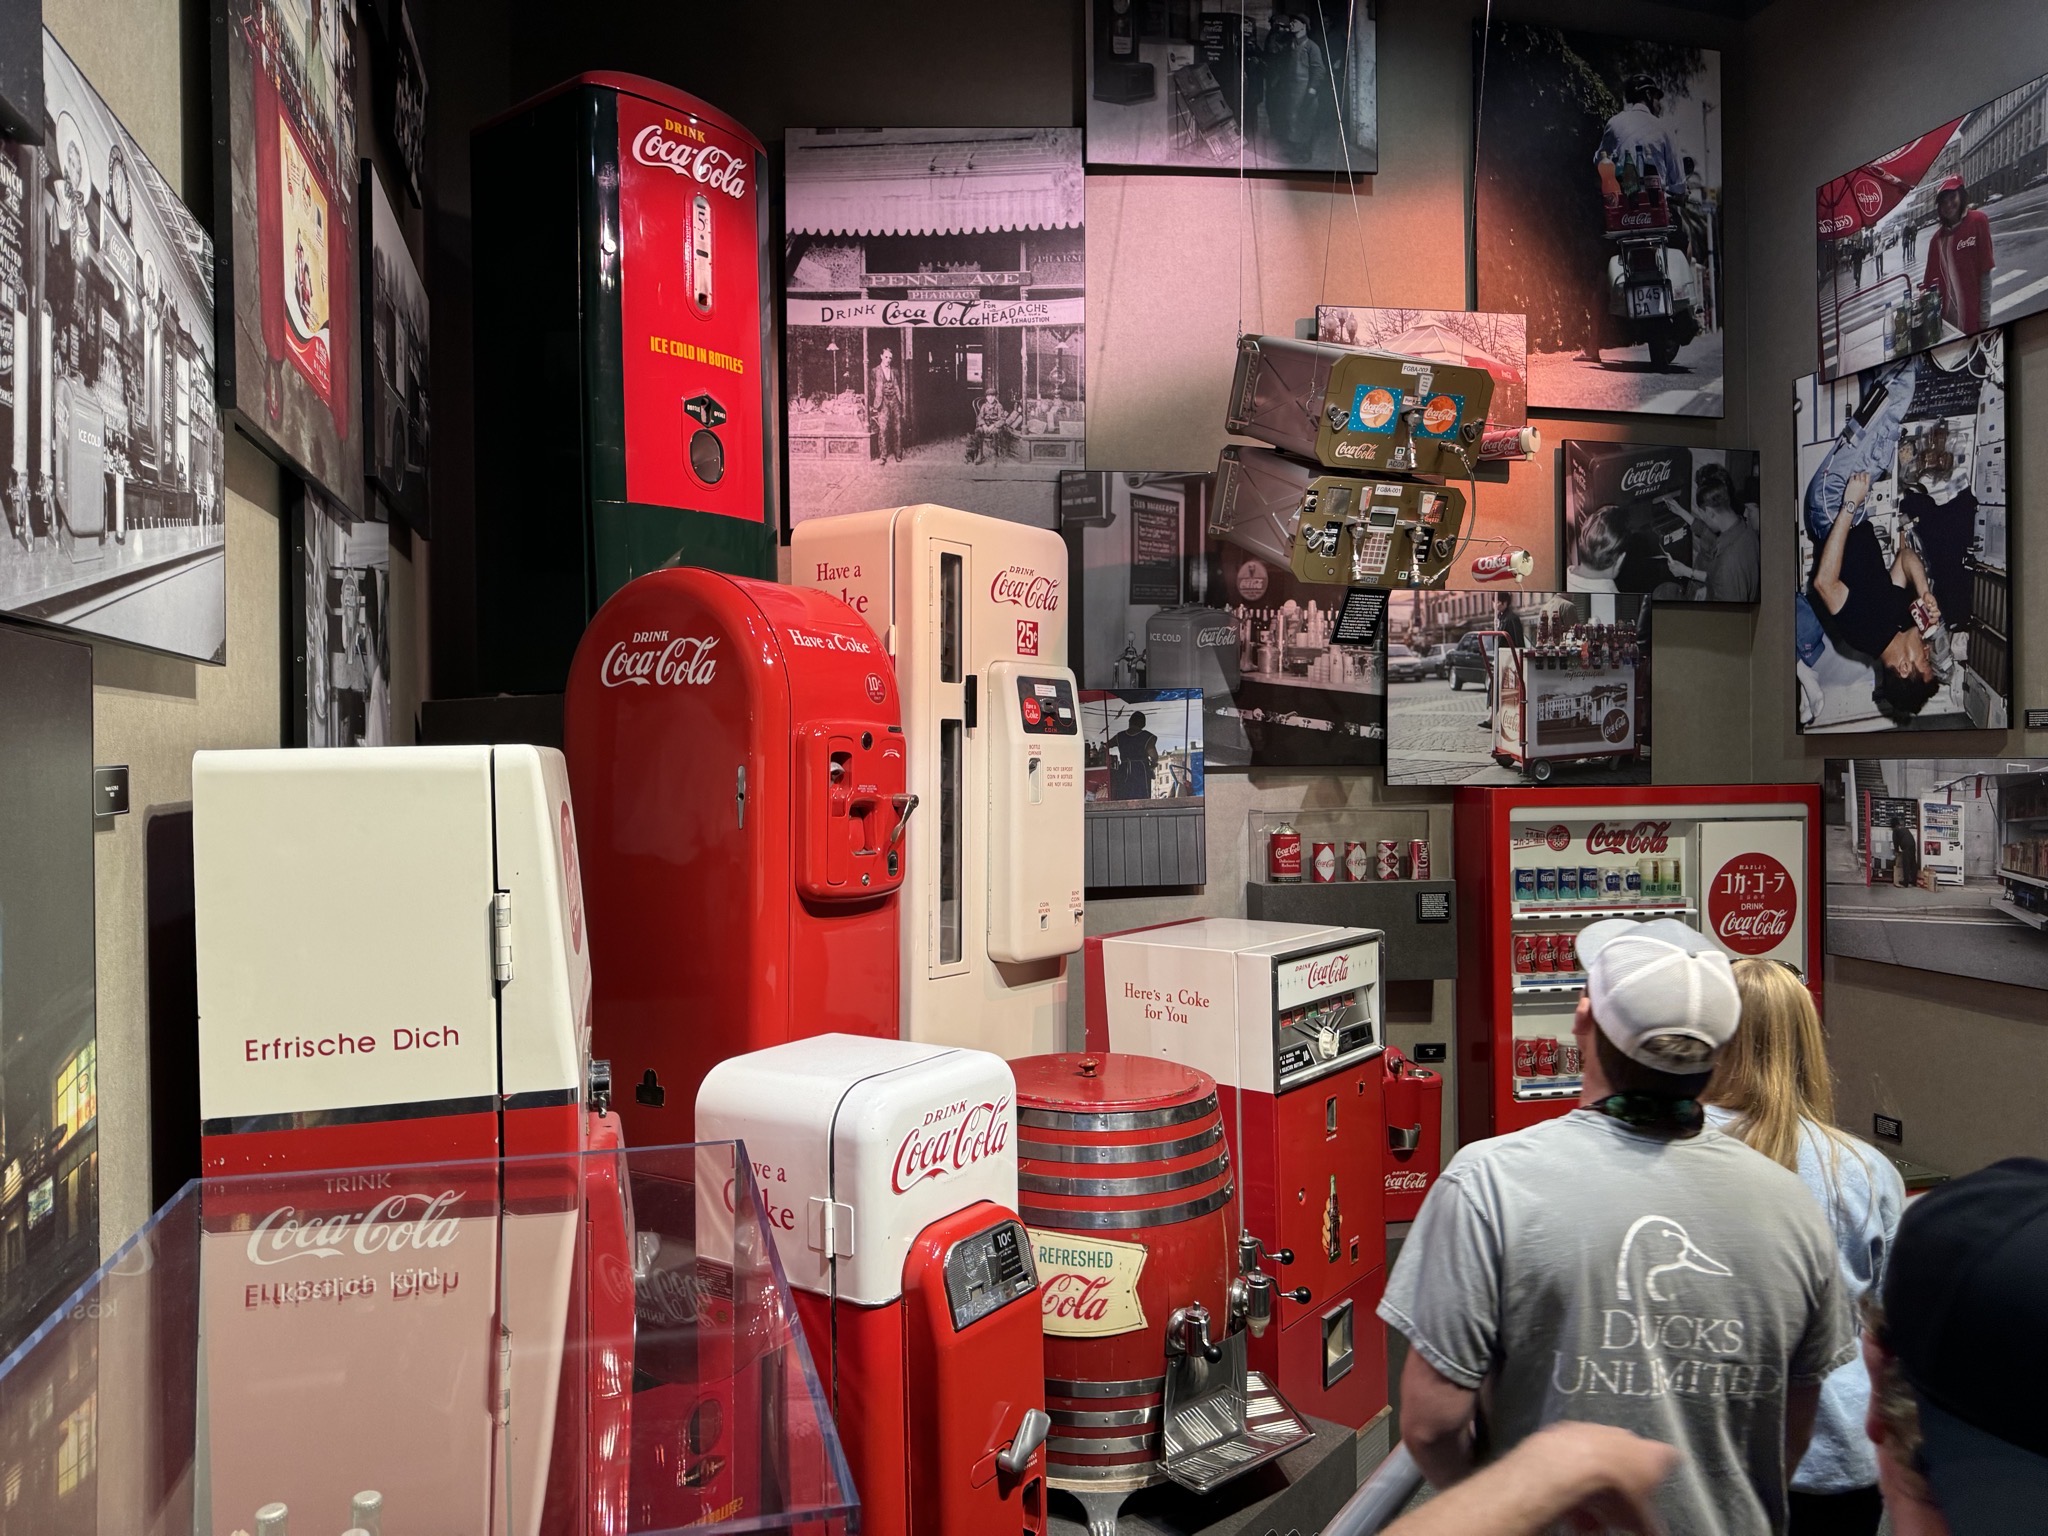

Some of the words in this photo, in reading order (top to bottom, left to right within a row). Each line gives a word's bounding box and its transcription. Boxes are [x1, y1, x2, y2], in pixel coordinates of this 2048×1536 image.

[664, 118, 706, 144] DRINK
[632, 125, 747, 199] Coca-Cola
[1621, 212, 1653, 226] Coca-Cola
[912, 291, 977, 300] PHARMACY
[821, 304, 876, 323] DRINK
[981, 303, 1049, 326] HEADACHE
[650, 336, 669, 354] ICE
[670, 340, 695, 360] COLD
[696, 346, 707, 364] IN
[708, 350, 744, 375] BOTTLES
[78, 429, 87, 443] ICE
[88, 432, 101, 448] COLD
[1335, 441, 1379, 461] Coca-Cola
[1621, 460, 1672, 492] Coca-Cola
[817, 563, 849, 582] Have
[854, 565, 862, 578] a
[1009, 566, 1035, 577] DRINK
[1477, 554, 1508, 571] Coke
[842, 588, 868, 613] ke
[991, 570, 1061, 611] Coca-Cola
[632, 631, 669, 643] DRINK
[787, 628, 825, 649] Have
[826, 638, 835, 650] a
[834, 633, 871, 653] Coke
[1018, 621, 1038, 649] 25¢
[1150, 633, 1161, 641] ICE
[1162, 633, 1181, 642] COLD
[1197, 625, 1238, 647] Coca-Cola
[601, 636, 720, 687] Coca-Cola
[1586, 821, 1672, 855] Coca-Cola
[1720, 872, 1786, 894] コカ・コーラ
[1720, 909, 1788, 937] Coca-Cola
[1308, 954, 1350, 989] Coca-Cola
[1124, 982, 1161, 1001] Here's
[1166, 993, 1173, 1003] a
[1178, 989, 1210, 1008] Coke
[1144, 1004, 1163, 1020] for
[1166, 1007, 1188, 1024] You
[245, 1033, 376, 1061] Erfrische
[393, 1025, 459, 1050] Dich
[922, 1100, 967, 1127] DRINK
[891, 1094, 1012, 1195] Coca-Cola
[324, 1173, 392, 1193] TRINK
[777, 1167, 787, 1183] a
[247, 1190, 467, 1265] Coca-Cola
[997, 1230, 1012, 1249] 10¢
[1039, 1246, 1113, 1268] REFRESHED
[280, 1275, 377, 1302] köstlich
[390, 1267, 438, 1290] kühl
[1042, 1273, 1115, 1320] Cola
[1601, 1309, 1744, 1354] DUCKS
[1552, 1350, 1783, 1397] UNLIMITED
